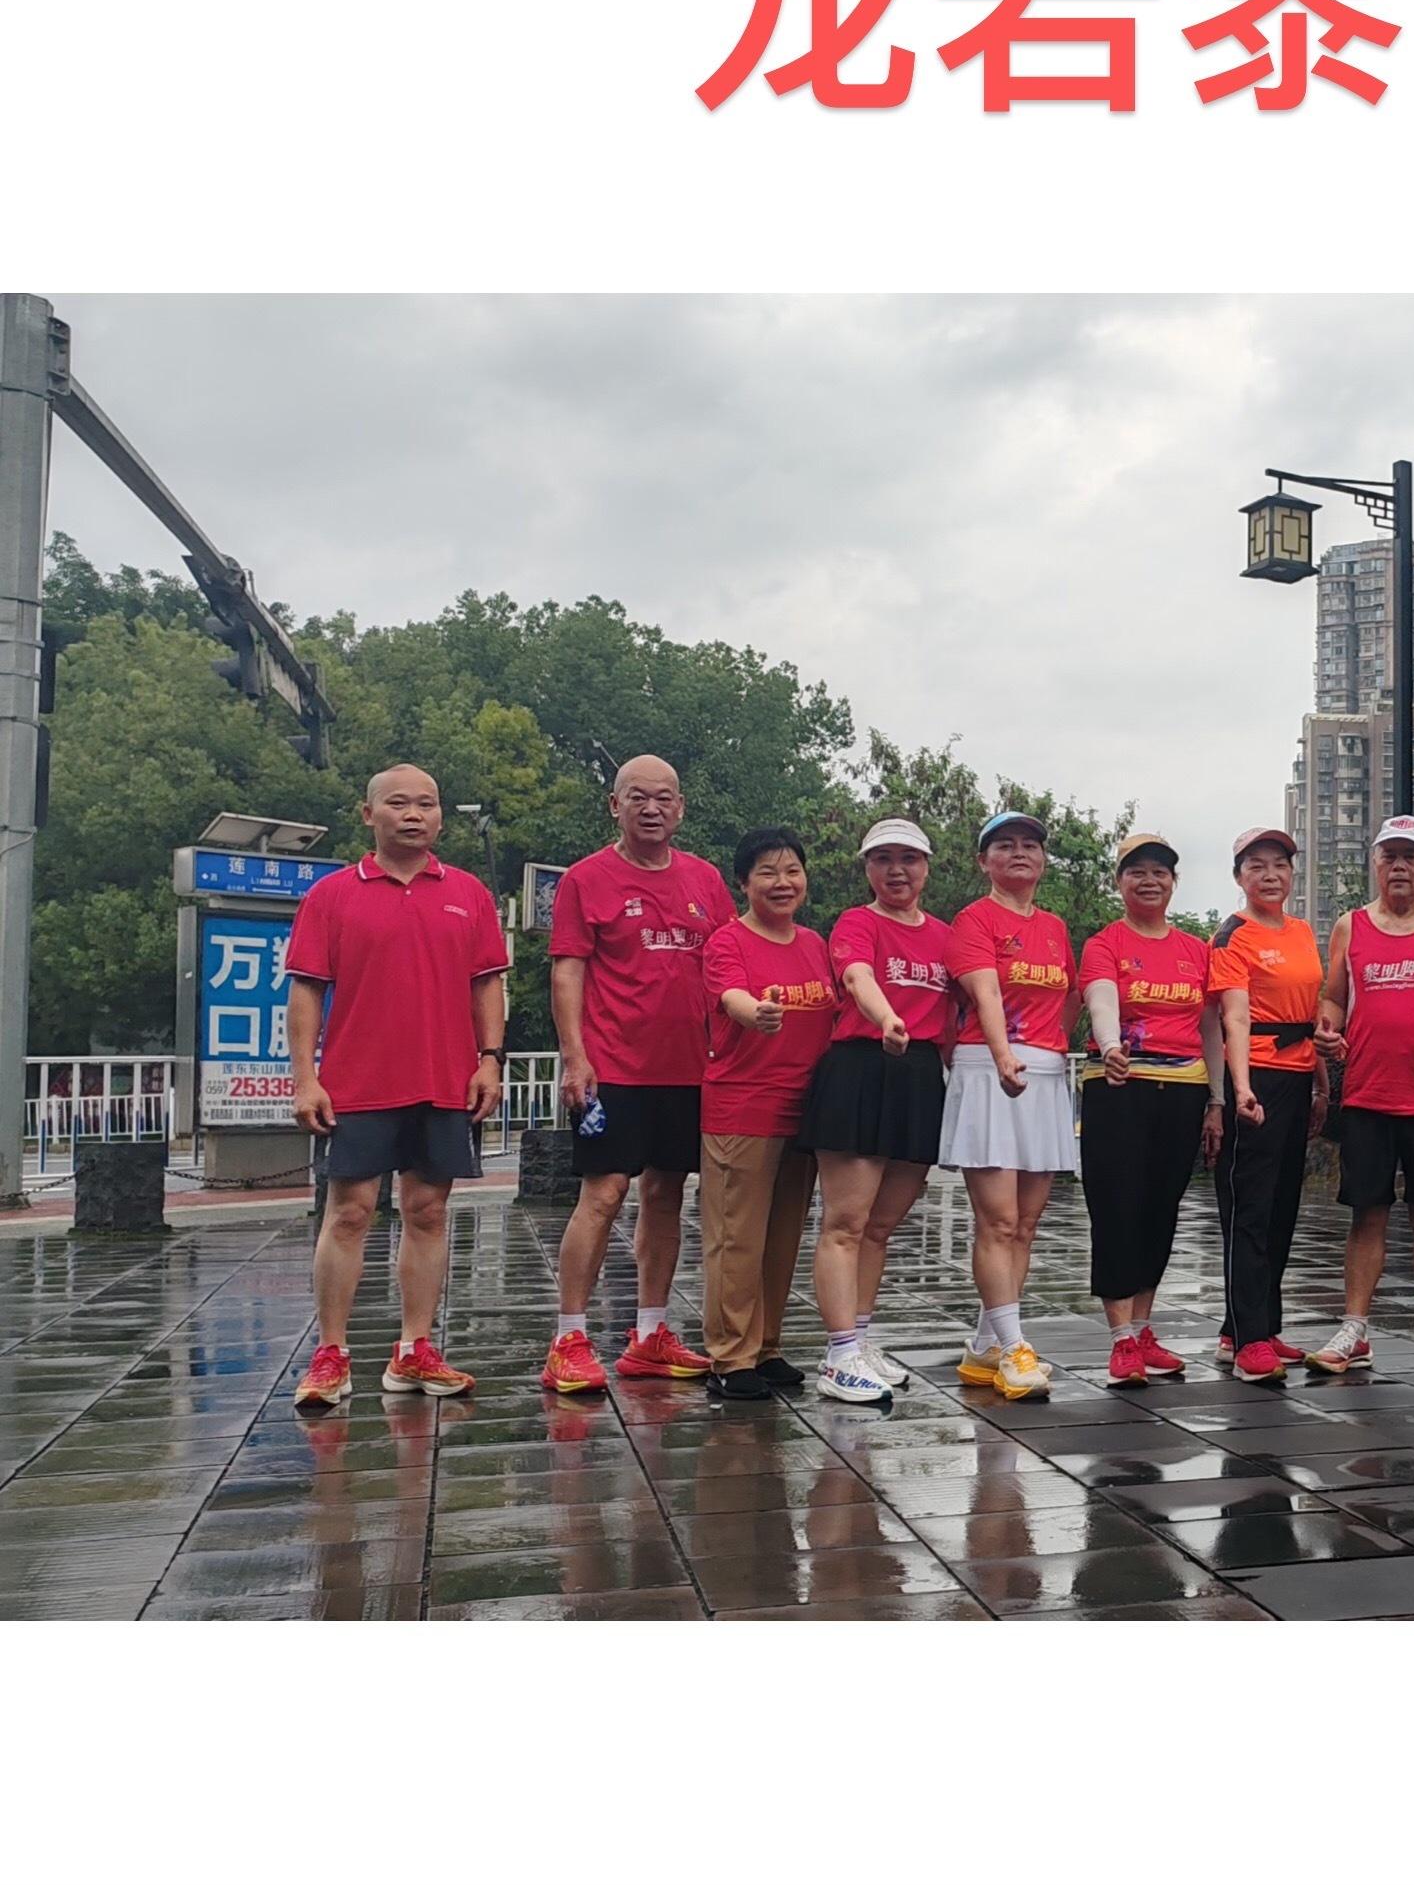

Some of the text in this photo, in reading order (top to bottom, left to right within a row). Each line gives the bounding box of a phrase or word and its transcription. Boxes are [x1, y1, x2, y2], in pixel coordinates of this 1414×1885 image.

[228, 856, 314, 881] 莲南路
[640, 928, 704, 950] 黎明脚步
[206, 1077, 295, 1097] 0597 25335
